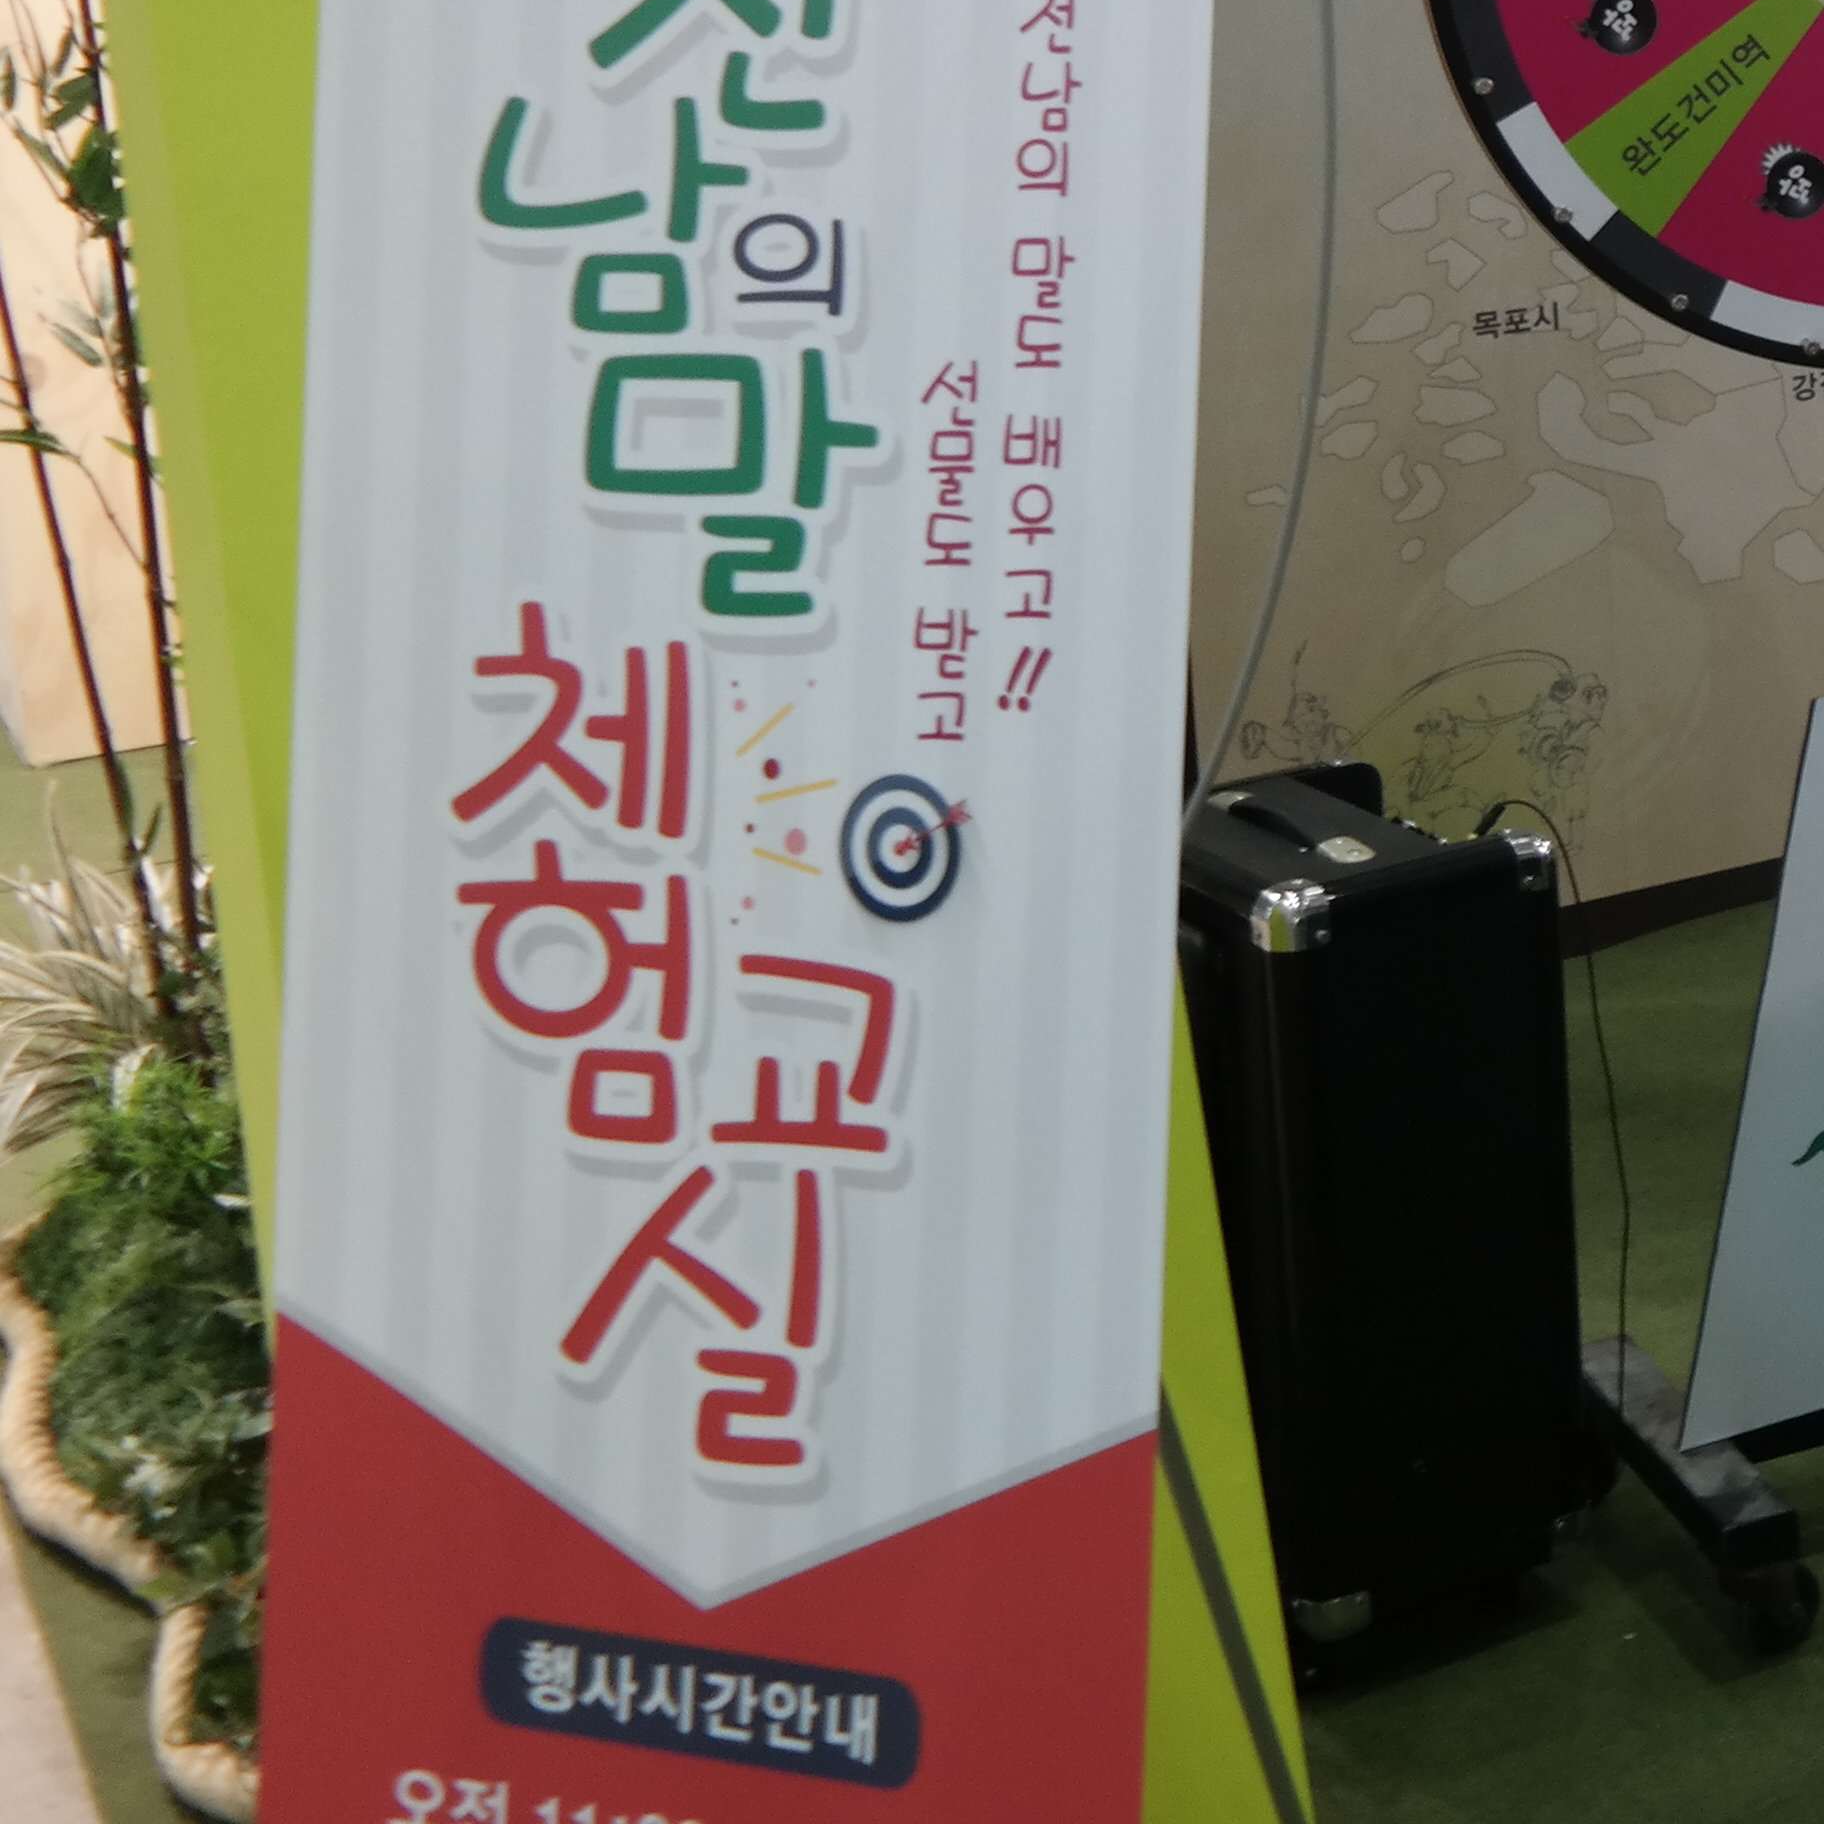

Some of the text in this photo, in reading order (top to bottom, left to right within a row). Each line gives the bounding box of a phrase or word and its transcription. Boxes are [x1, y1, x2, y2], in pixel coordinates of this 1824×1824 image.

[1008, 233, 1076, 373] 말도
[1471, 301, 1563, 339] 목포시
[586, 345, 879, 617] 말
[913, 606, 981, 743] 받고
[519, 1639, 880, 1766] 행사시간안내
